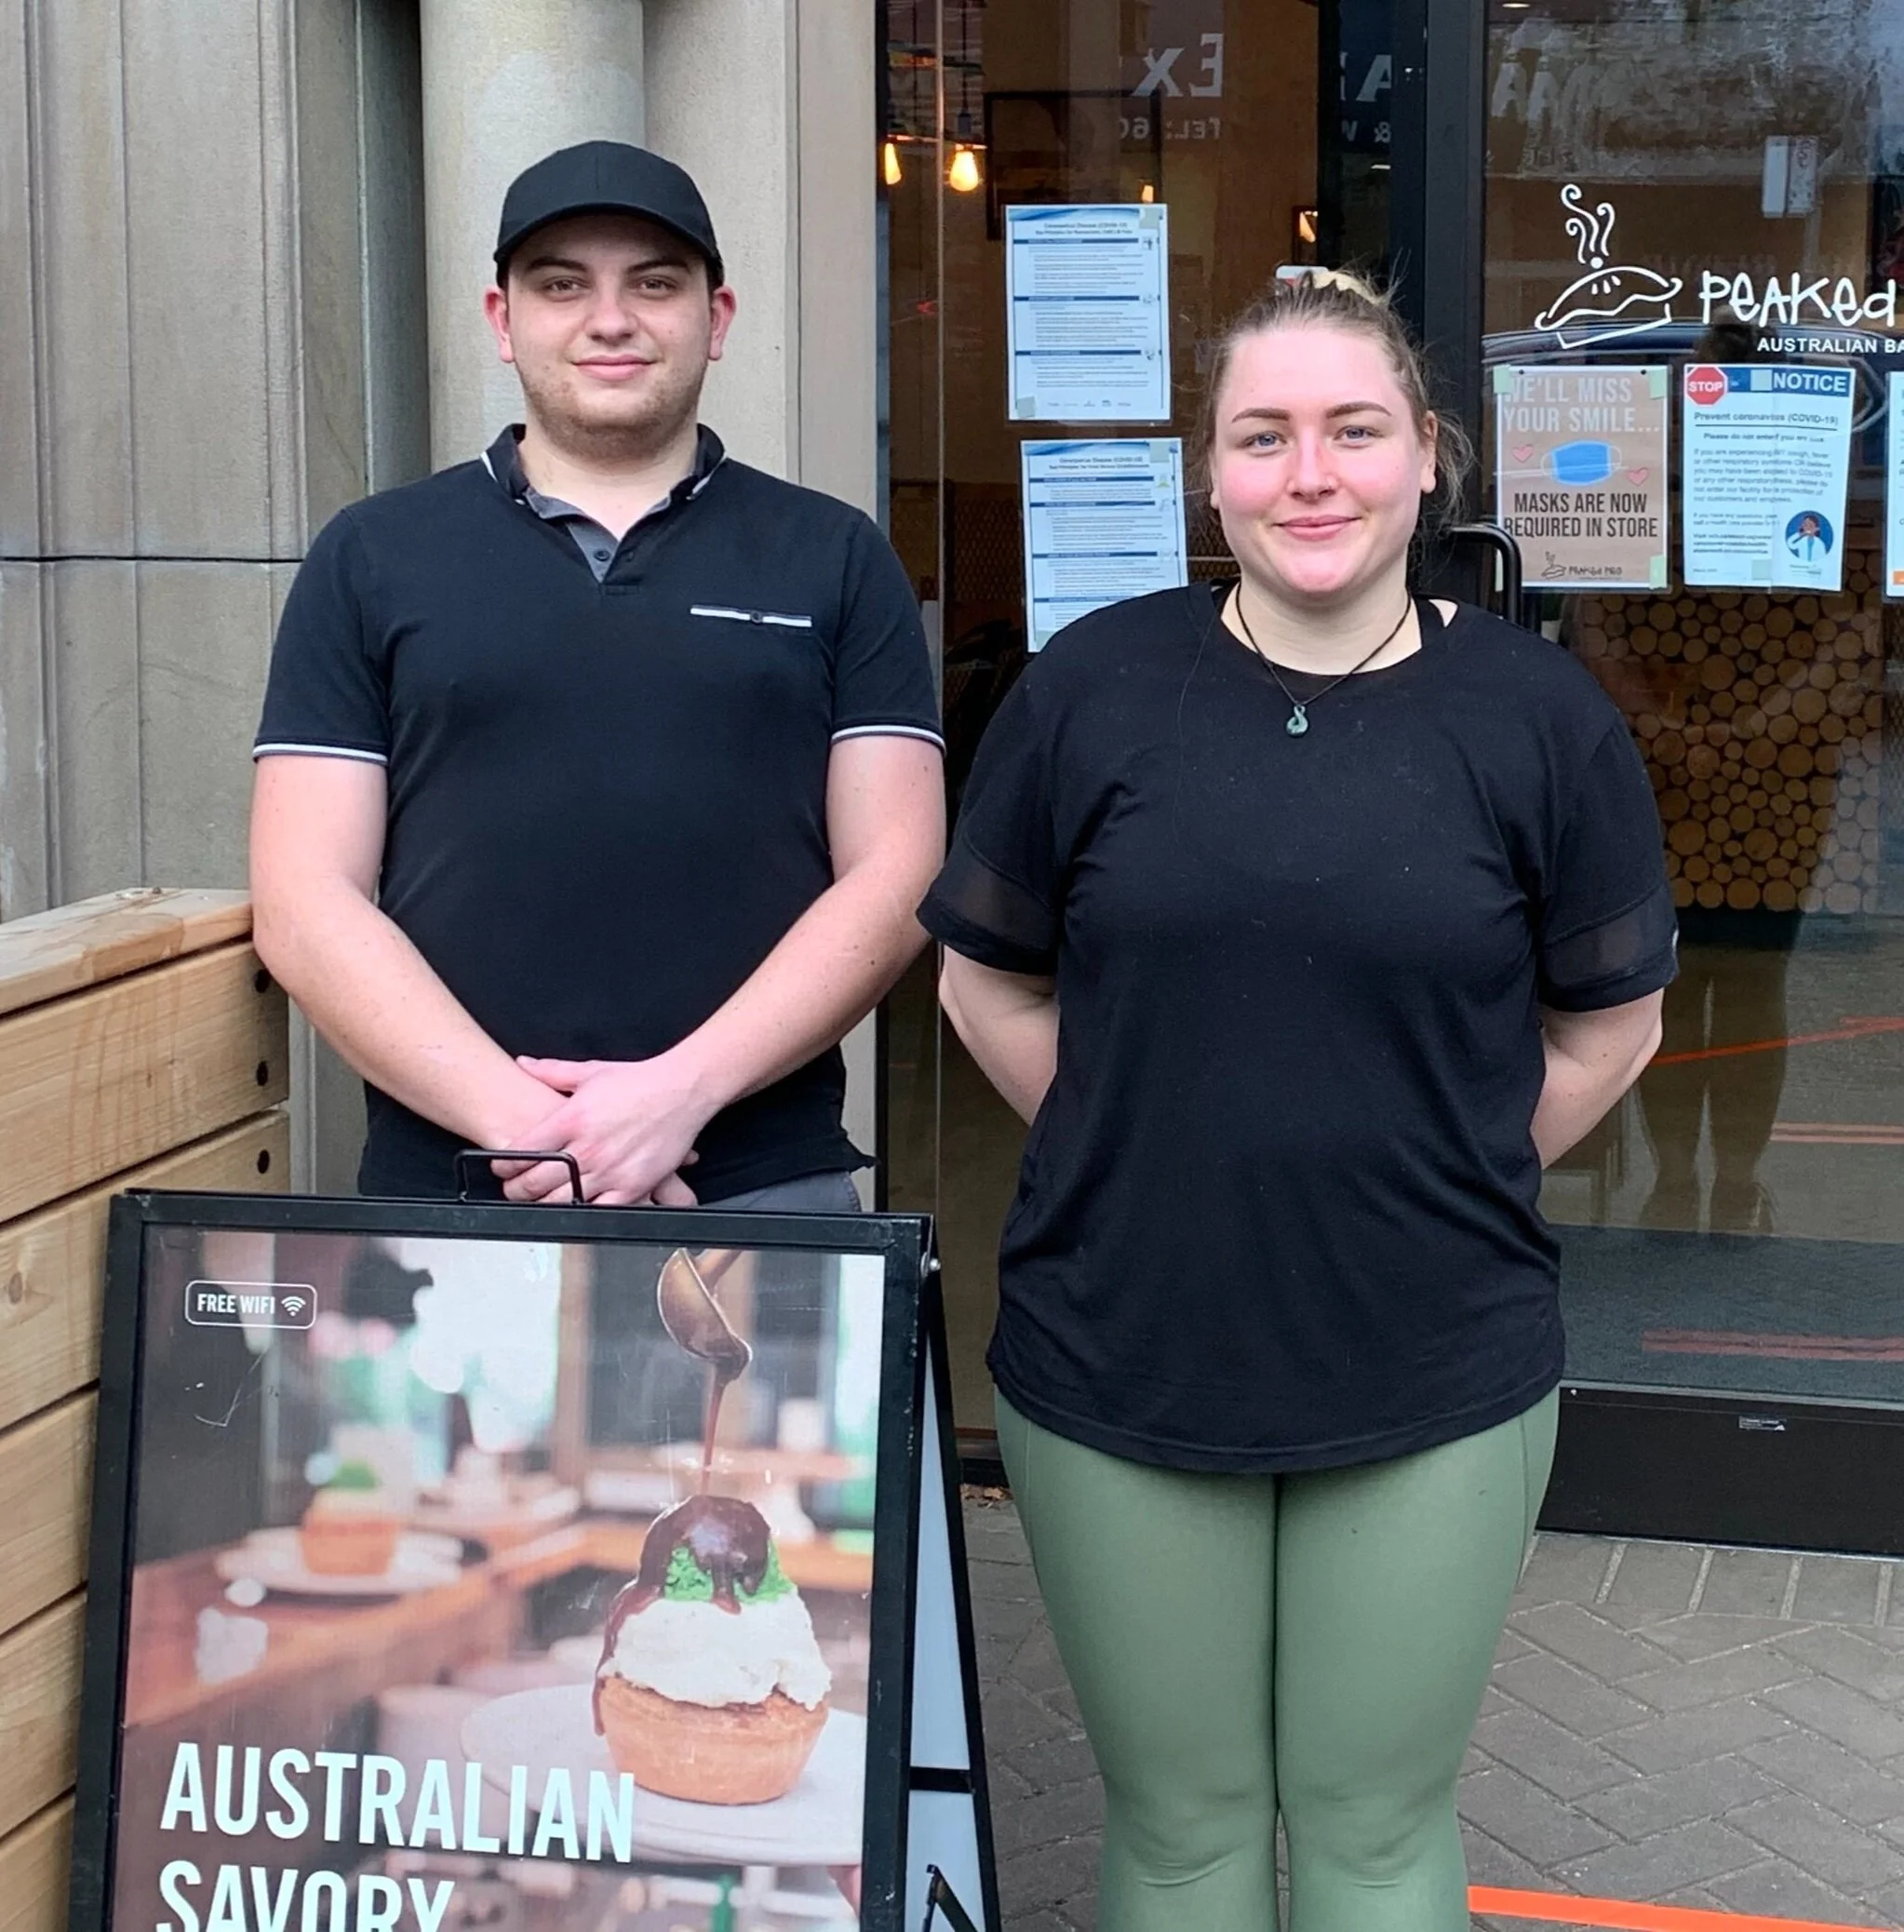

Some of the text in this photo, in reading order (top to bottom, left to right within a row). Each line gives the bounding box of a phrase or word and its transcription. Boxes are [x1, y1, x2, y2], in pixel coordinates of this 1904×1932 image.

[1756, 338, 1877, 354] AUSTRALIAN
[1577, 377, 1632, 404] MISS
[1688, 372, 1847, 393] STOP NOTICE
[1503, 407, 1660, 433] YOUR SMILE...
[1694, 411, 1731, 421] Prevent
[1514, 492, 1647, 513] MASKS ARE NOW
[1503, 517, 1658, 538] REQUIRED IN STORE
[196, 1293, 276, 1315] FREE WIFI
[160, 1742, 635, 1863] AUSTRALIAN
[155, 1860, 456, 1932] SAVORY
